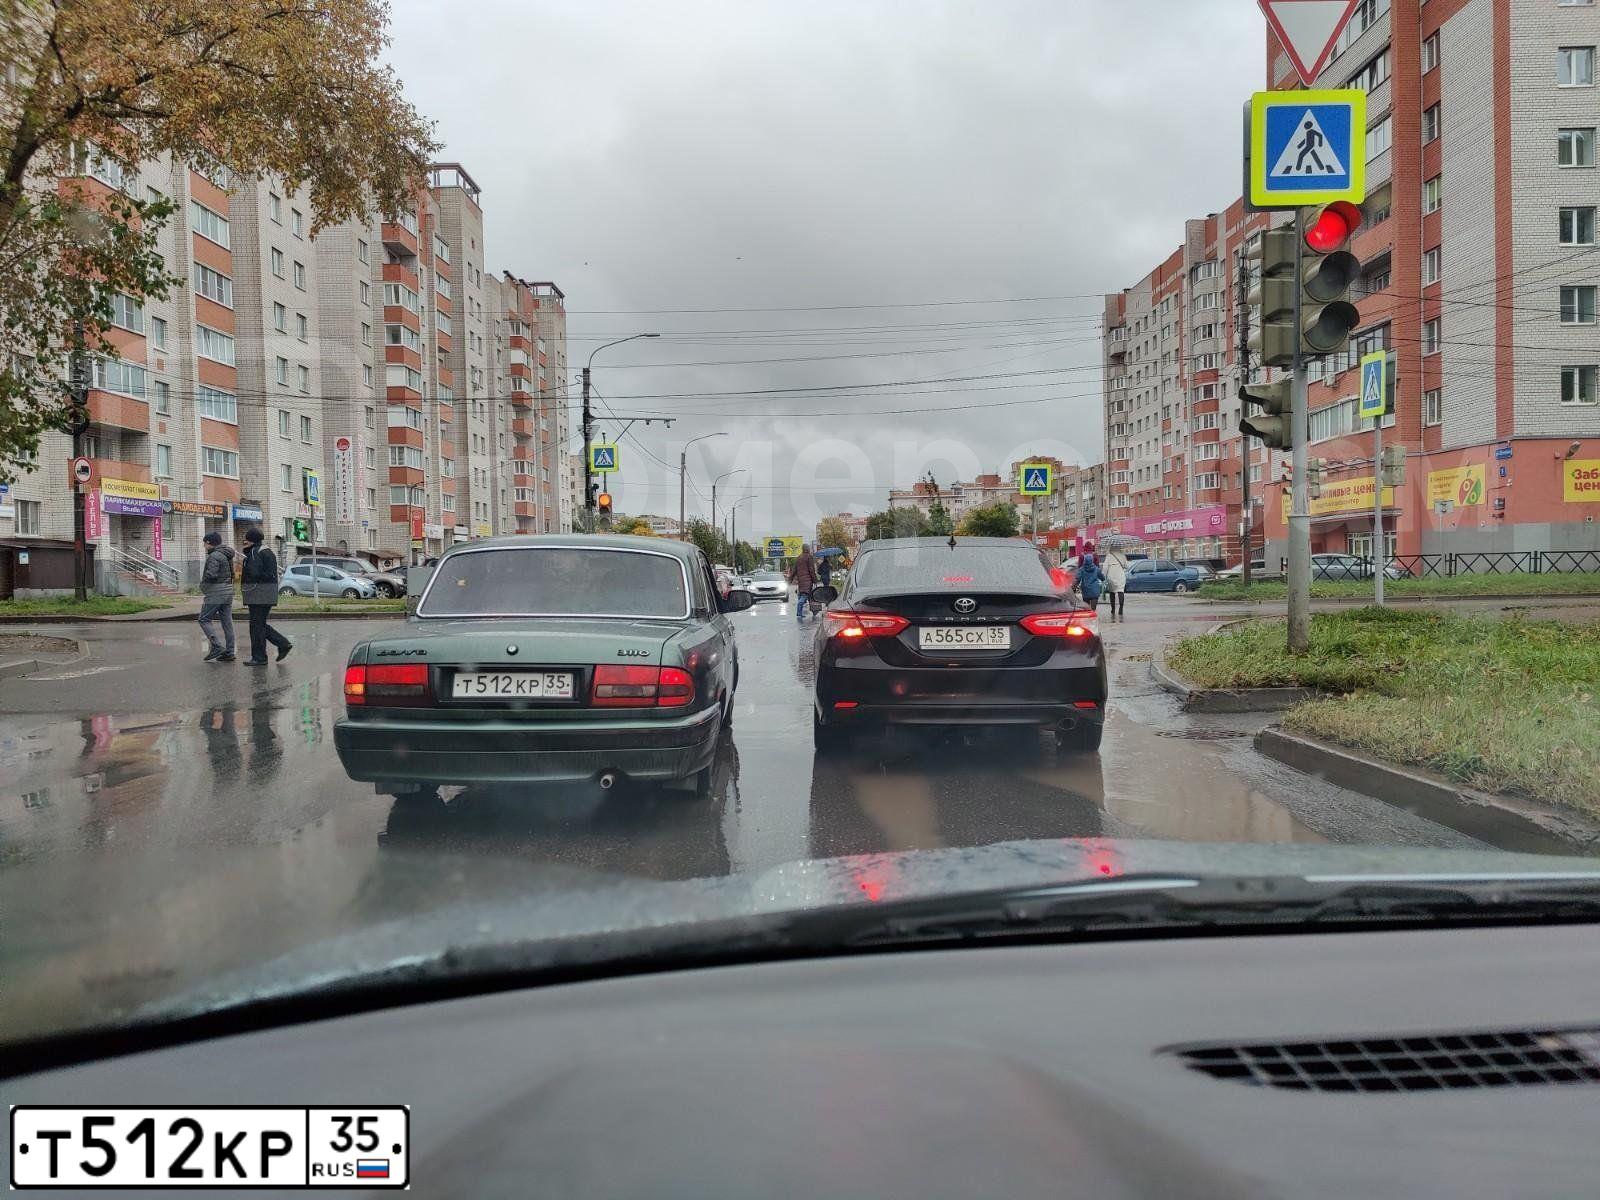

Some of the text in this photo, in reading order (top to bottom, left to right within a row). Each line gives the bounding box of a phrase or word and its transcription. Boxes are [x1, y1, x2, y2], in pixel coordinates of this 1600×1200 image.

[104, 496, 162, 508] ПАРИКМАХЕРСКАЯ
[88, 493, 97, 536] АТЕЛЬЕ
[924, 627, 1005, 643] А565СХ 35
[462, 674, 566, 694] Т512КР 35
